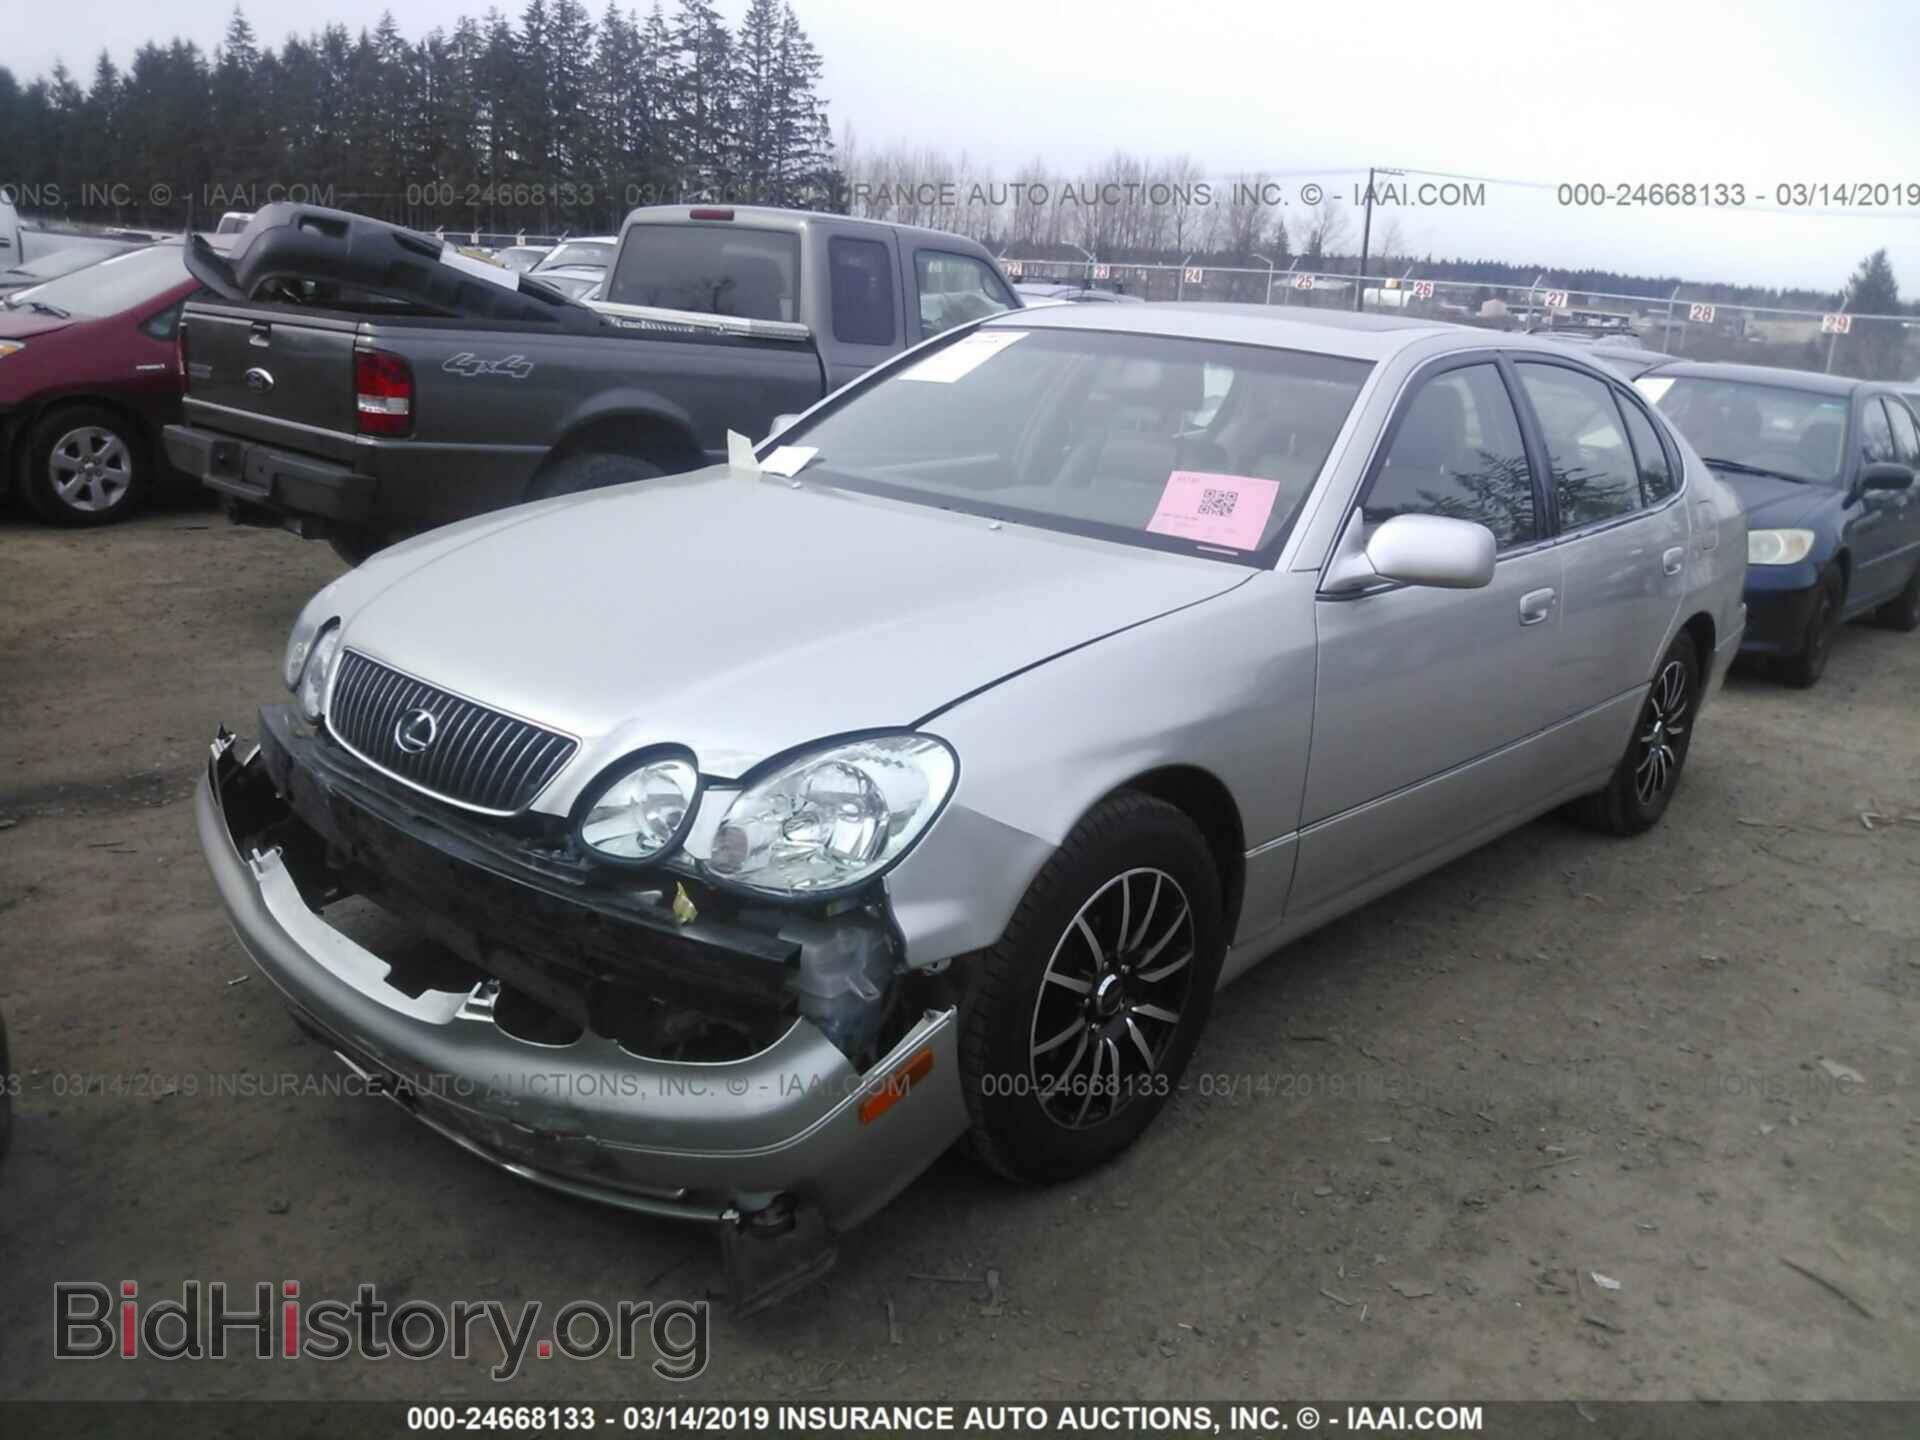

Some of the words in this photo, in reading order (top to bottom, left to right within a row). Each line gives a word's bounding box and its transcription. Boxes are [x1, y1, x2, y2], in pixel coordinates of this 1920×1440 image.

[1095, 264, 1109, 278] 23
[1186, 269, 1200, 282] 24
[1297, 275, 1312, 288] 25
[1416, 283, 1431, 296] 26
[1549, 292, 1565, 305] 27
[1693, 305, 1712, 321] 28
[1826, 315, 1846, 330] 29
[442, 352, 534, 378] 4x4
